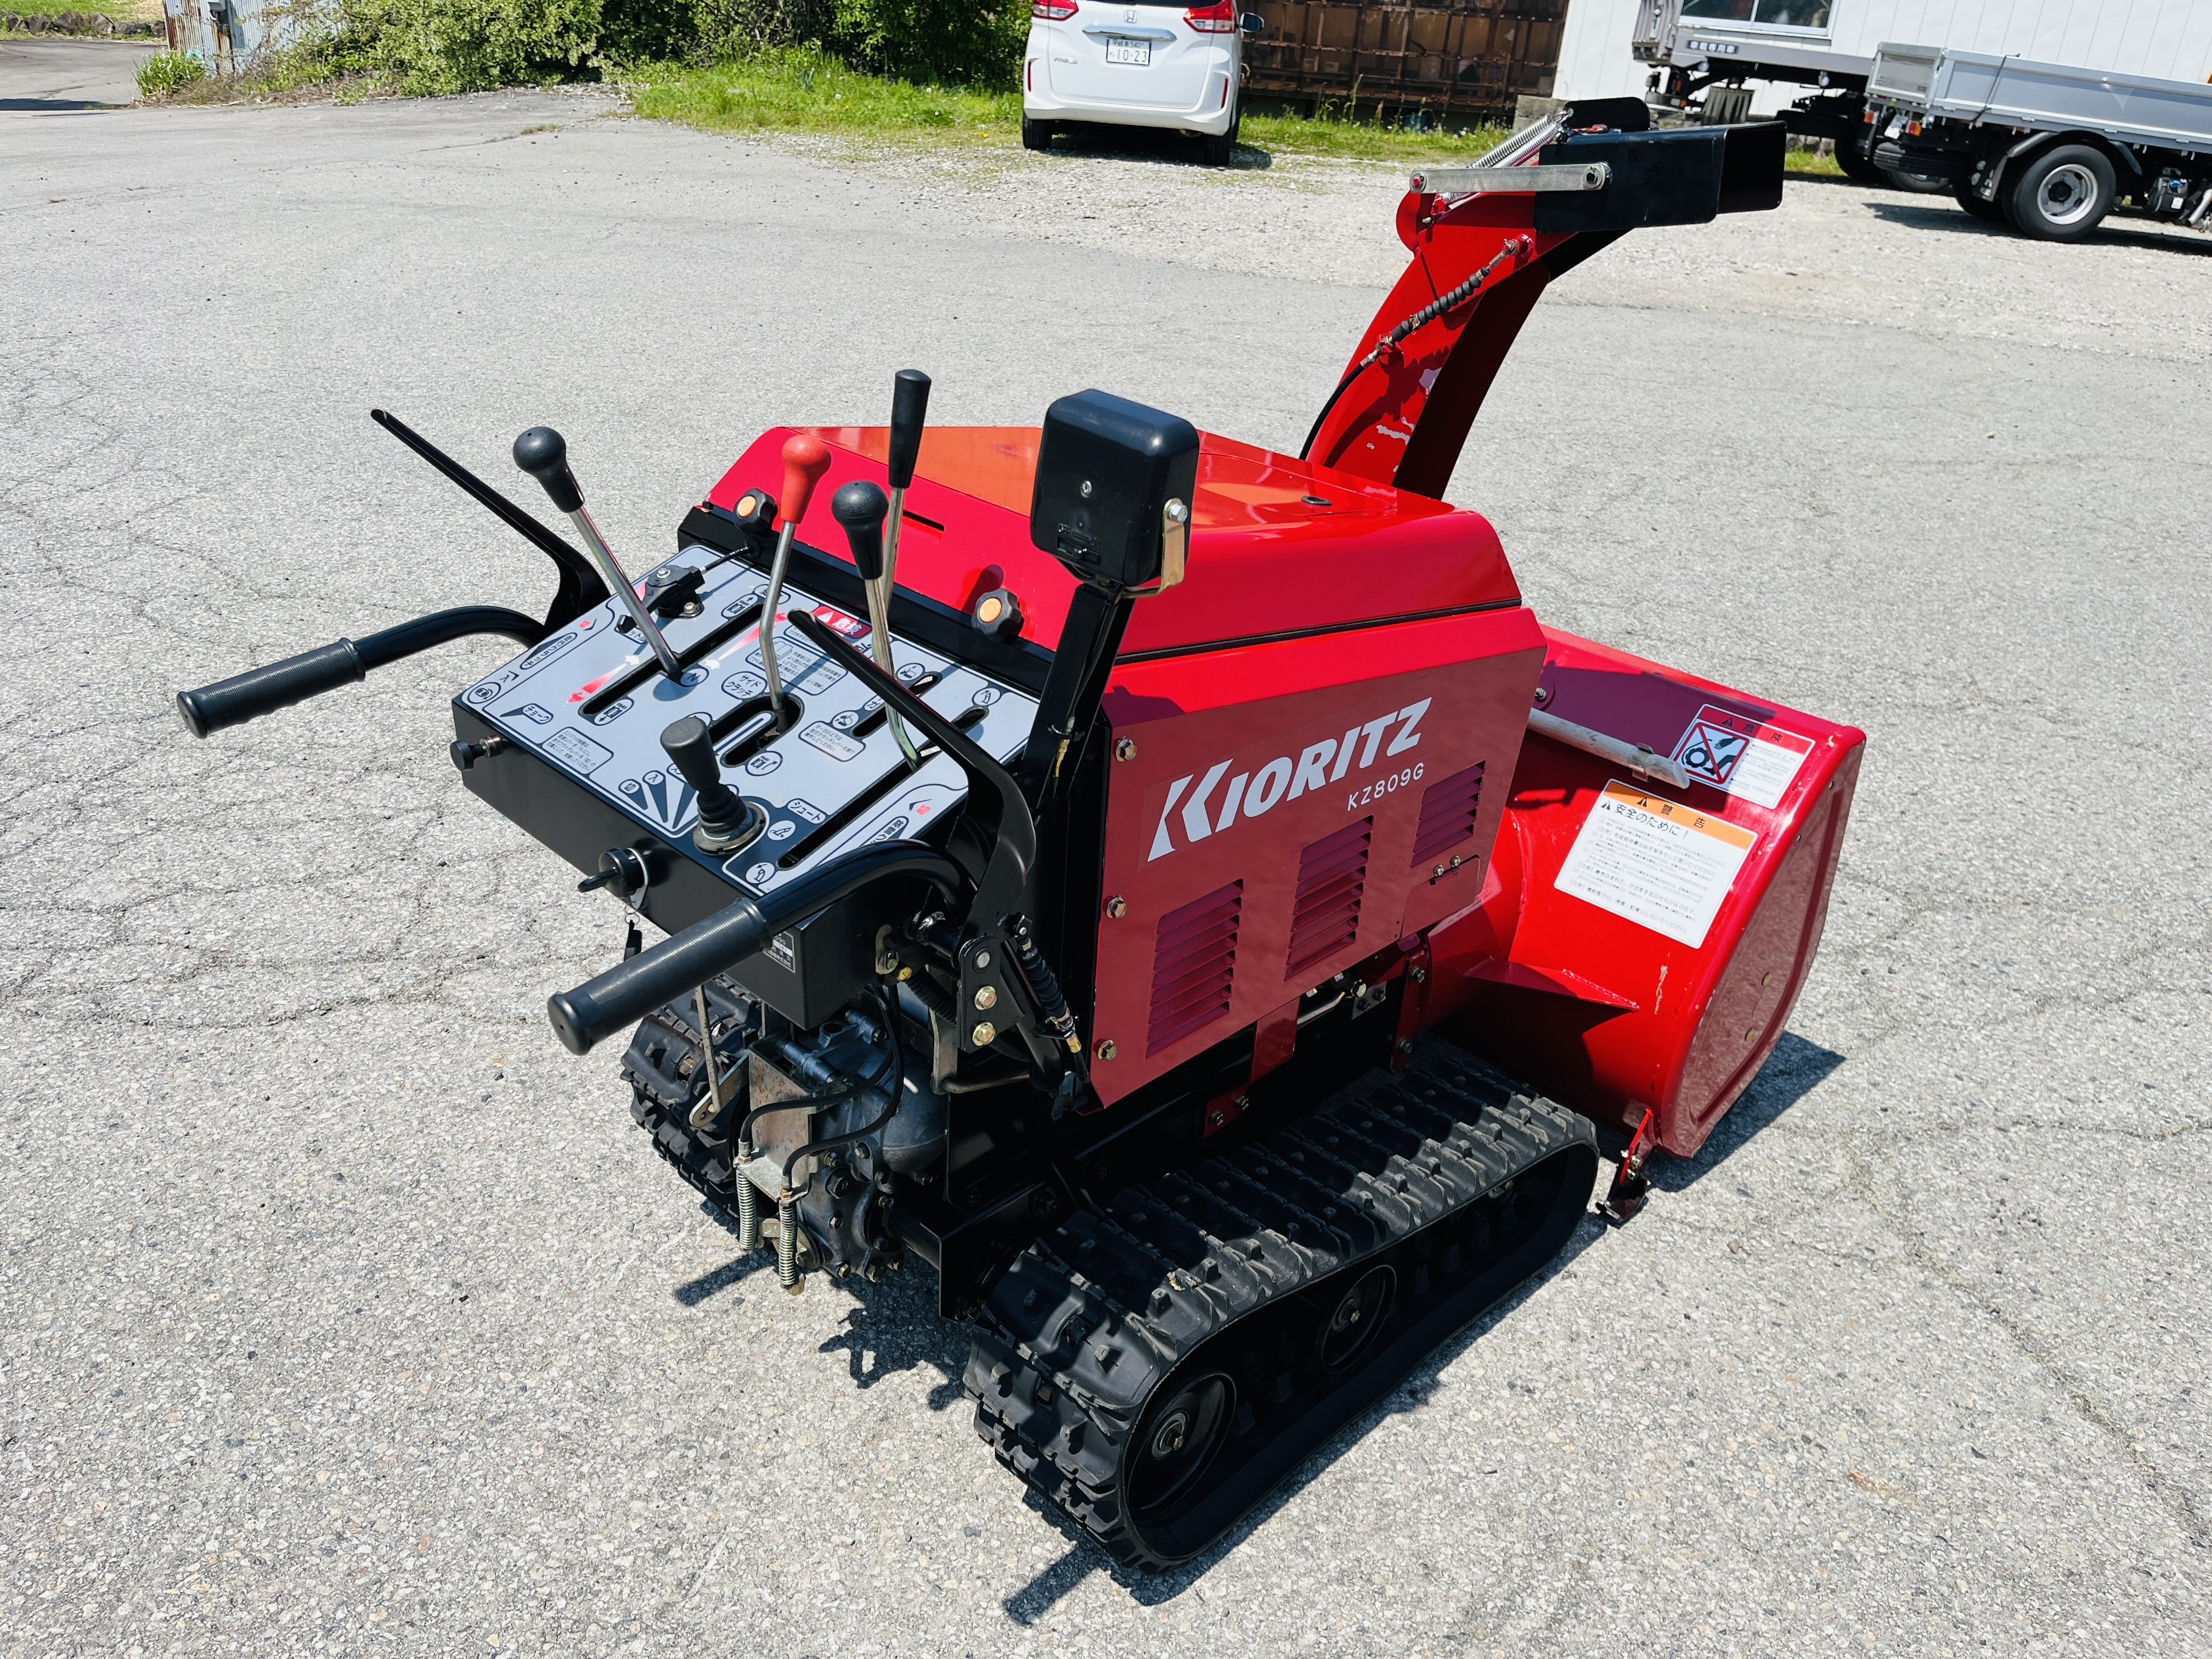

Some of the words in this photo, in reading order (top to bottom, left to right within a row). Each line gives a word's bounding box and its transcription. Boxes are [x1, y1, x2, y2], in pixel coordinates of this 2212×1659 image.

[1118, 49, 1147, 63] 10-23
[687, 672, 701, 682] N
[740, 674, 762, 688] サイド
[725, 680, 754, 697] クラッチ
[523, 704, 550, 723] チョーク
[647, 774, 659, 783] 入
[1148, 697, 1432, 862] KIORITZ
[1347, 762, 1425, 811] KZ809G
[794, 800, 821, 822] シュート
